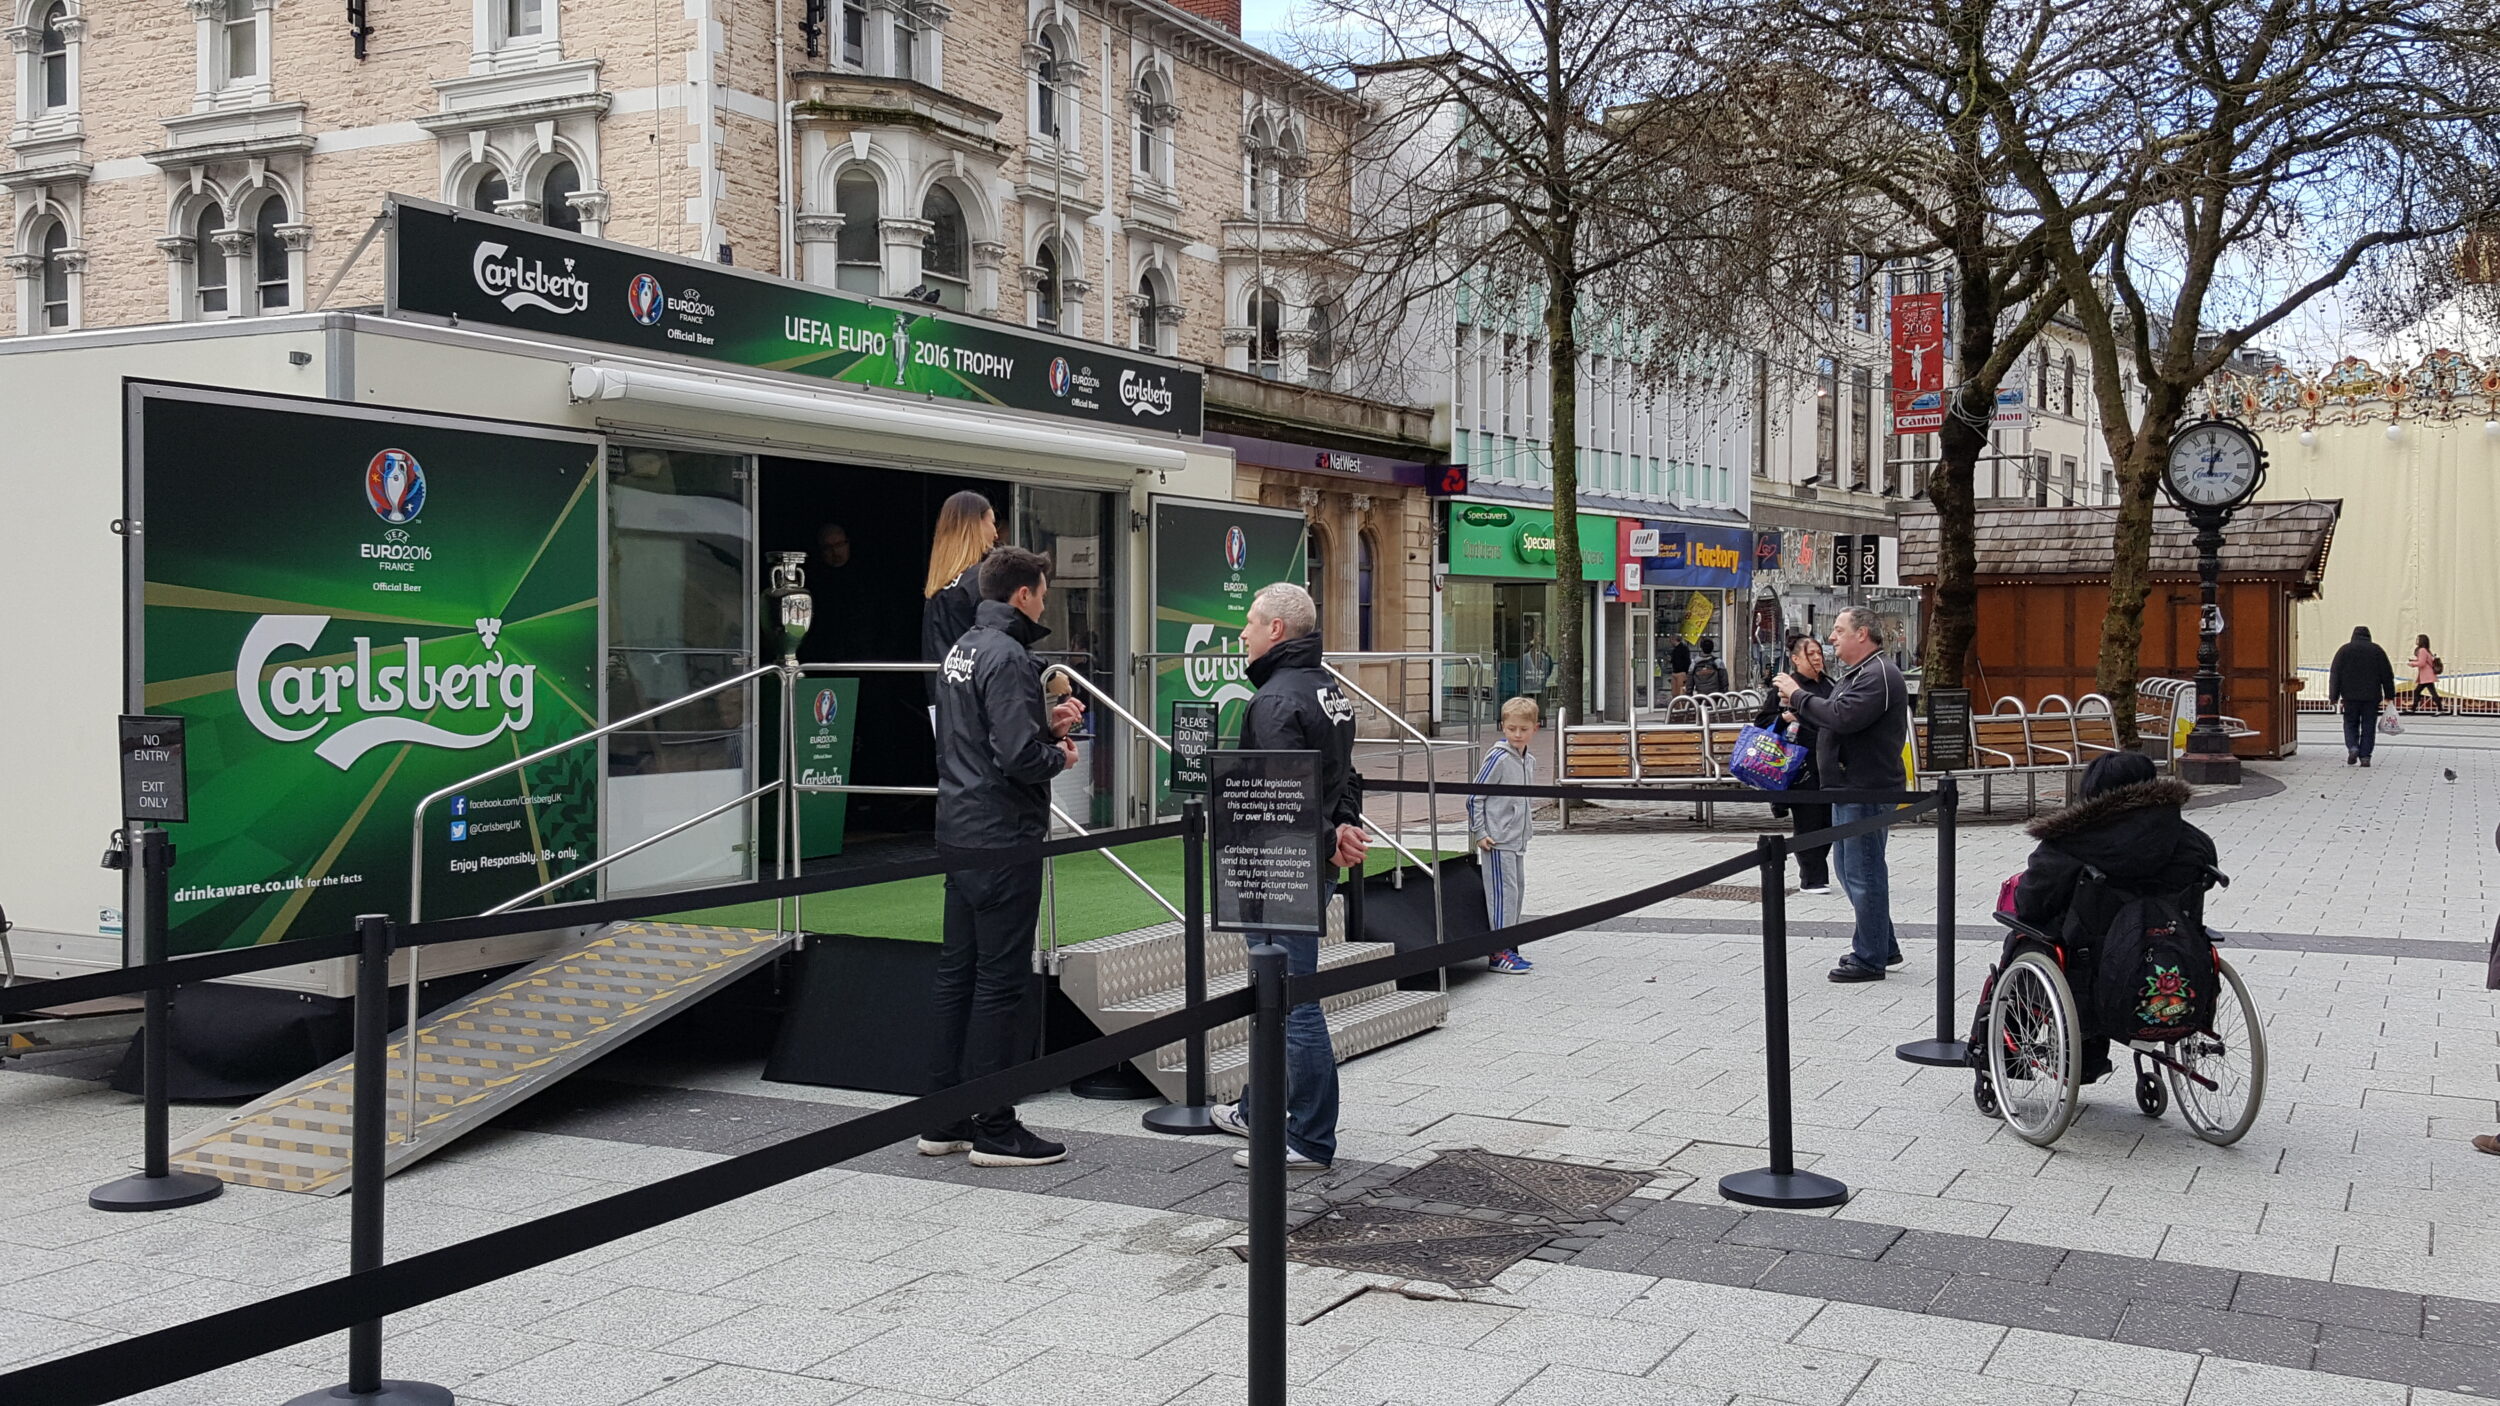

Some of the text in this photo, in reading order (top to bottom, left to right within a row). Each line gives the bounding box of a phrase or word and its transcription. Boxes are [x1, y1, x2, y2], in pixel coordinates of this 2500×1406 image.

[473, 241, 589, 312] Carlsberg
[667, 297, 715, 317] EURO2016
[679, 313, 703, 325] FRANCE
[667, 328, 715, 346] Official Beer
[785, 315, 1015, 381] UEFA EURO 2016 TROPHY
[1119, 369, 1172, 413] Carlsberg
[1330, 453, 1361, 473] NatWest
[1466, 510, 1508, 521] Specsavers
[385, 531, 408, 543] UEFA
[1523, 533, 1556, 552] Specsave
[361, 543, 432, 561] EURO2016
[1695, 542, 1740, 574] Factory
[379, 562, 416, 572] FRANCE
[1863, 544, 1875, 583] next
[372, 582, 422, 592] Official Beer
[236, 614, 536, 755] Carlsberg
[1180, 716, 1209, 728] PLEASE
[143, 734, 160, 746] NO
[1179, 730, 1209, 742] DO NOT
[134, 749, 170, 762] ENTRY
[1180, 744, 1207, 755] TOUCH
[1185, 757, 1201, 769] THE
[802, 767, 842, 785] Carlsberg
[1177, 770, 1207, 783] TROPHY
[141, 780, 165, 793] EXIT
[1226, 778, 1302, 790] Due to UK legislation
[469, 793, 562, 809] facebook.com/CarlsbergUK
[1250, 790, 1276, 798] alcohol
[1278, 790, 1304, 800] brands,
[139, 796, 168, 809] ONLY
[1227, 800, 1301, 812] this activity is strictly
[1233, 812, 1243, 822] for
[1263, 812, 1276, 821] 18's
[1277, 813, 1296, 824] only.
[469, 820, 522, 836] @CarlsbergUK
[1224, 845, 1307, 856] Carlsberg would like to
[450, 846, 580, 874] Enjoy Responsibly. 18+ only.
[1221, 857, 1311, 868] send its sincere apologies
[1237, 869, 1251, 878] any
[1252, 868, 1268, 878] fans
[1270, 870, 1294, 878] unable
[1296, 870, 1304, 878] to
[174, 873, 363, 903] drinkaware.co.uk for the facts
[1224, 879, 1308, 890] have their picture taken
[1238, 890, 1254, 899] with
[1256, 891, 1267, 899] the
